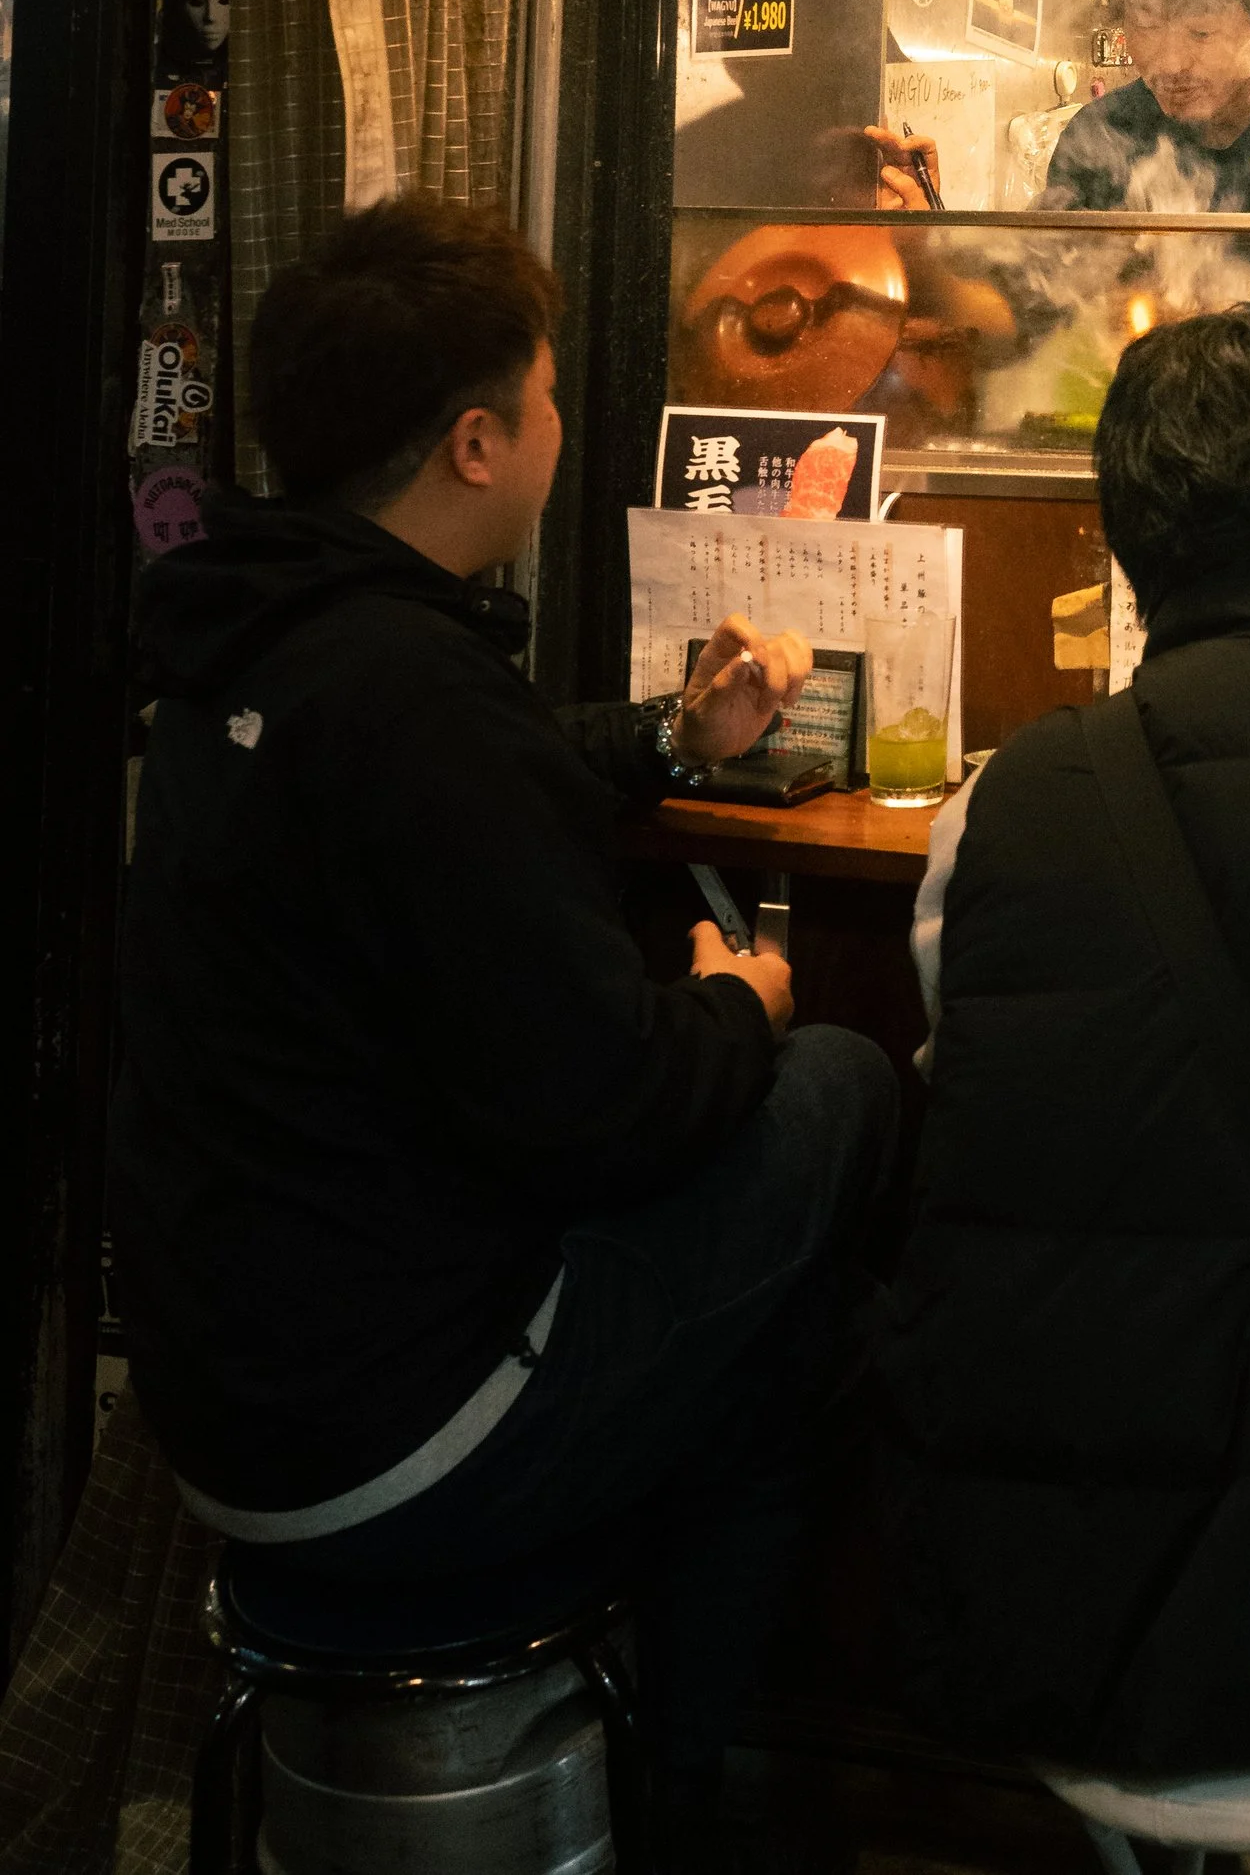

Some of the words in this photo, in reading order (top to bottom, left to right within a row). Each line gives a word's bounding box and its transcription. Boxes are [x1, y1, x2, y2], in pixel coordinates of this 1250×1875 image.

[744, 1, 787, 33] ¥1,980
[888, 73, 932, 106] WAGYU
[155, 218, 177, 228] Med
[179, 218, 210, 228] School
[166, 228, 201, 236] MOOSE
[140, 343, 155, 403] Anywhere
[152, 345, 181, 443] OluKai
[137, 404, 151, 439] Aloha
